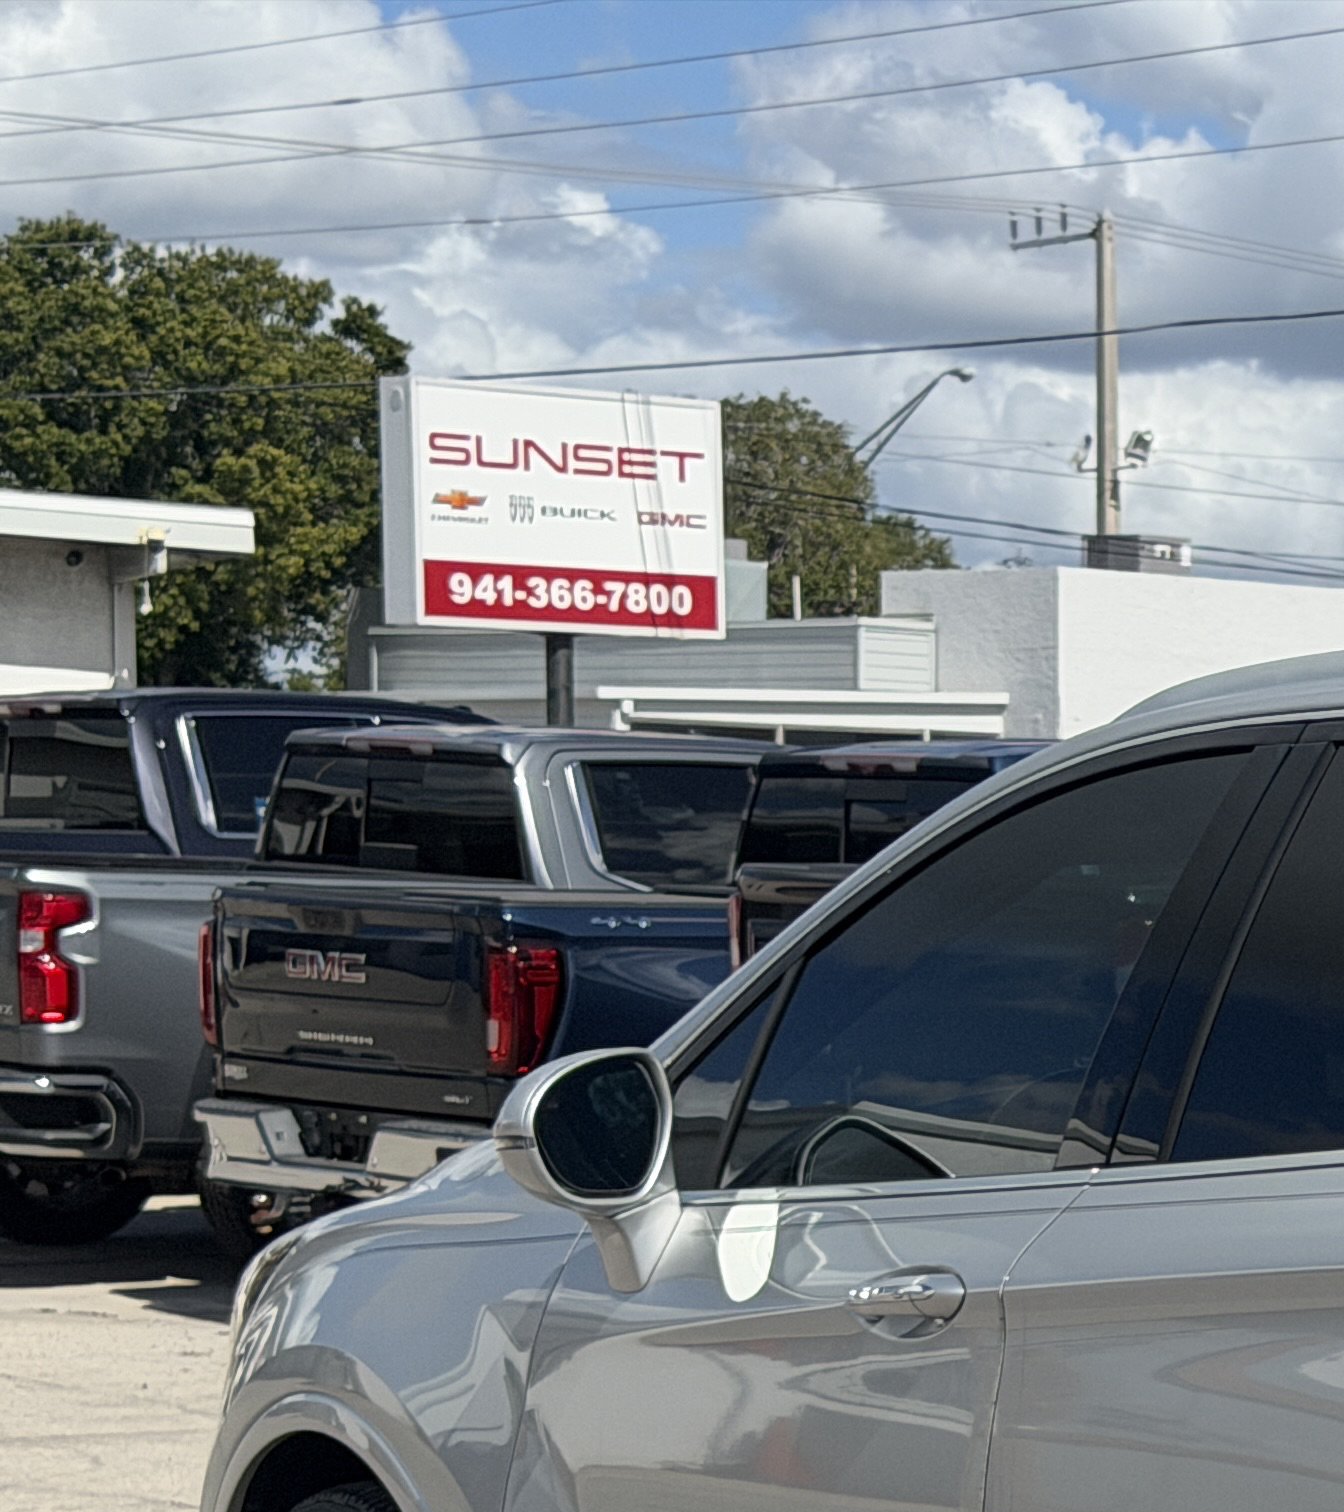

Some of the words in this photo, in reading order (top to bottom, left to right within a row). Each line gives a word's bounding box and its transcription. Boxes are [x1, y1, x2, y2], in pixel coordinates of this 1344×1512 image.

[429, 432, 705, 483] SUNSET
[540, 505, 618, 522] BUICK
[637, 511, 707, 529] GMC
[449, 572, 693, 616] 941-366-7800
[285, 949, 367, 984] GMC
